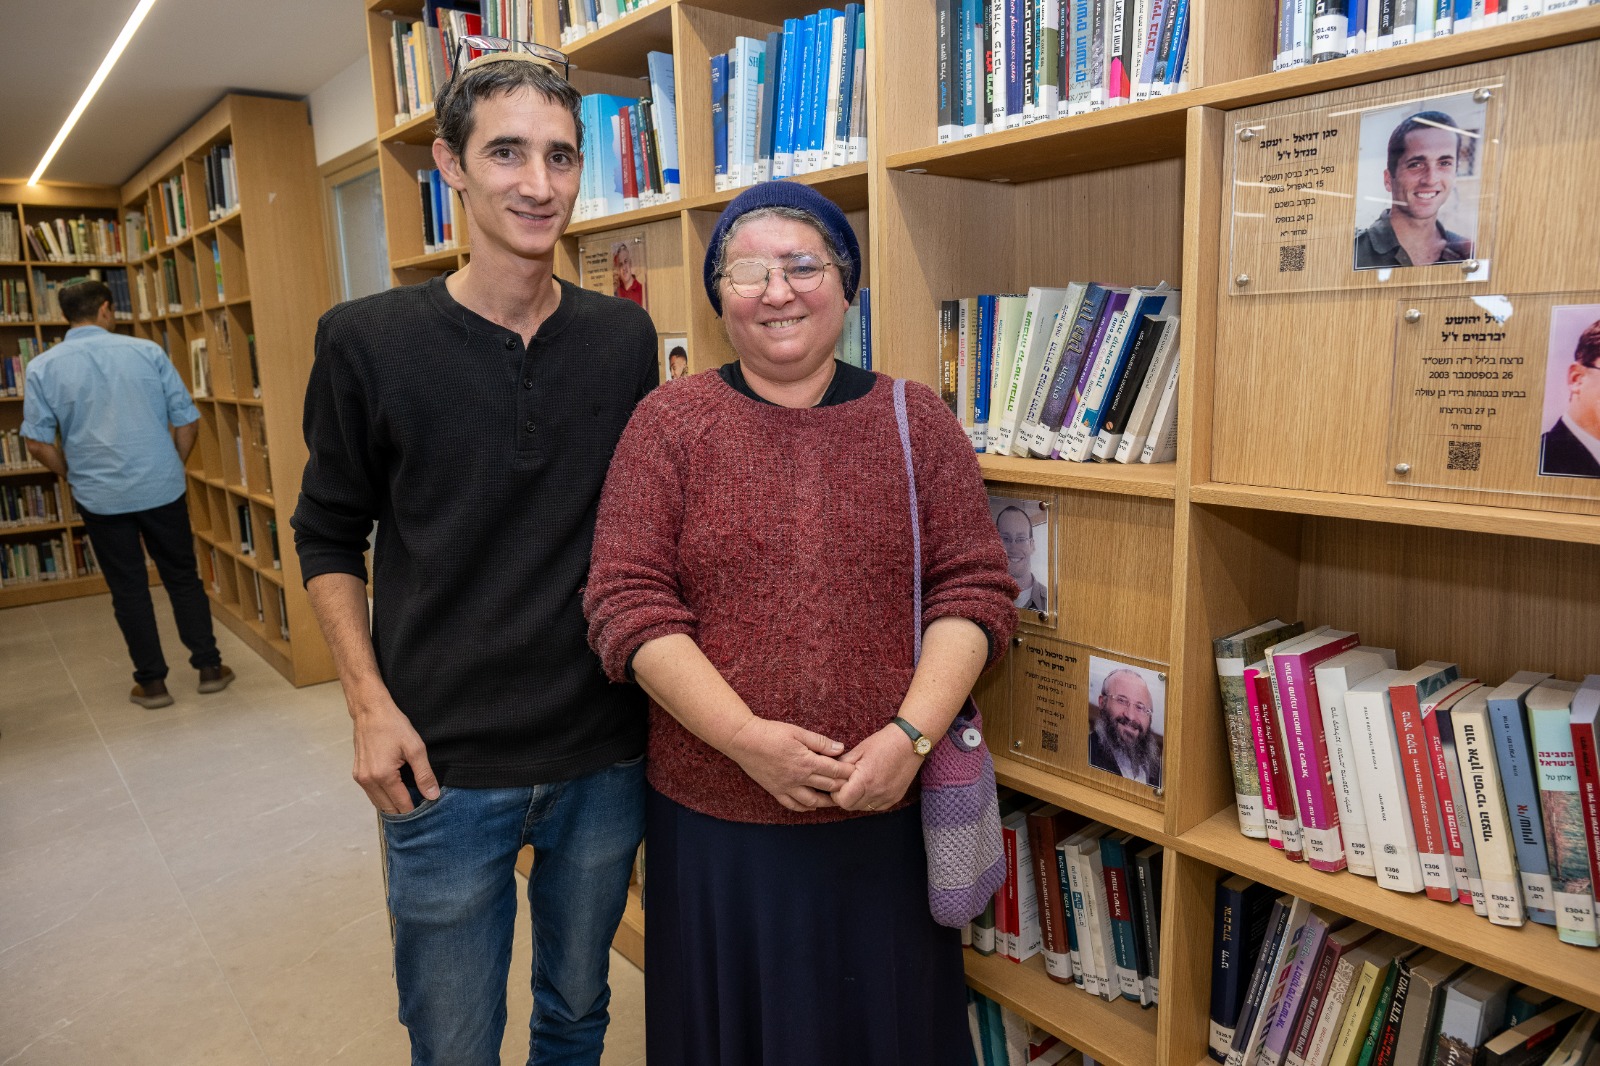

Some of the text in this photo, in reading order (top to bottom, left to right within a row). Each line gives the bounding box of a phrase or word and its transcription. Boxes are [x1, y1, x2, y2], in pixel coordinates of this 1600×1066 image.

[1144, 21, 1158, 55] בלבד
[993, 40, 1001, 74] מדבר
[1075, 35, 1087, 82] חושבים
[1024, 61, 1030, 77] הר
[1260, 138, 1282, 149] יעקב
[1293, 132, 1319, 143] דניאל
[1323, 129, 1338, 140] סגן
[1294, 148, 1317, 158] מנדל
[1285, 171, 1302, 180] בניסן
[1321, 166, 1334, 174] נפל
[1287, 182, 1312, 190] באפריל
[1316, 180, 1324, 188] 15
[1275, 198, 1316, 208] בקרב בשכם
[1307, 214, 1314, 222] בן
[1104, 316, 1118, 343] עמוס עוז
[1114, 308, 1130, 334] קולות
[1446, 316, 1480, 325] יהושע
[1042, 340, 1057, 372] הדרוזים
[1103, 334, 1119, 365] קוראים
[1012, 349, 1025, 380] קליטה
[1476, 356, 1496, 364] בליל
[1056, 364, 1068, 383] הלל
[1095, 366, 1108, 388] לציון
[1429, 371, 1450, 379] 2003
[1034, 371, 1047, 397] במזרח
[1415, 388, 1436, 396] עוולה
[1006, 381, 1018, 411] עבודה
[1438, 390, 1446, 399] בן
[1502, 390, 1526, 398] בביתו
[1025, 397, 1040, 422] התיכון
[1488, 408, 1496, 418] בן
[1284, 661, 1308, 778] העדפה מתקנת והבטחת ייצוג בישראל
[1401, 709, 1418, 754] מראי מקום
[1431, 735, 1448, 780] צביה גרינפילד
[1539, 758, 1575, 766] בישראל
[1462, 722, 1475, 745] מוני
[1478, 810, 1493, 842] הנצחי
[1443, 798, 1453, 813] הם
[1422, 814, 1431, 834] חברתיים
[1446, 814, 1460, 849] מפחדים
[1385, 866, 1400, 874] E306
[1111, 892, 1121, 916] בישראל
[1492, 894, 1514, 902] E305.2
[1565, 906, 1590, 915] E304.2
[1222, 906, 1231, 941] אדם ברוך
[1276, 963, 1304, 1029] דמוקרטיה בישראל
[1394, 976, 1409, 1000] מאיר
[1306, 995, 1319, 1016] אתרים
